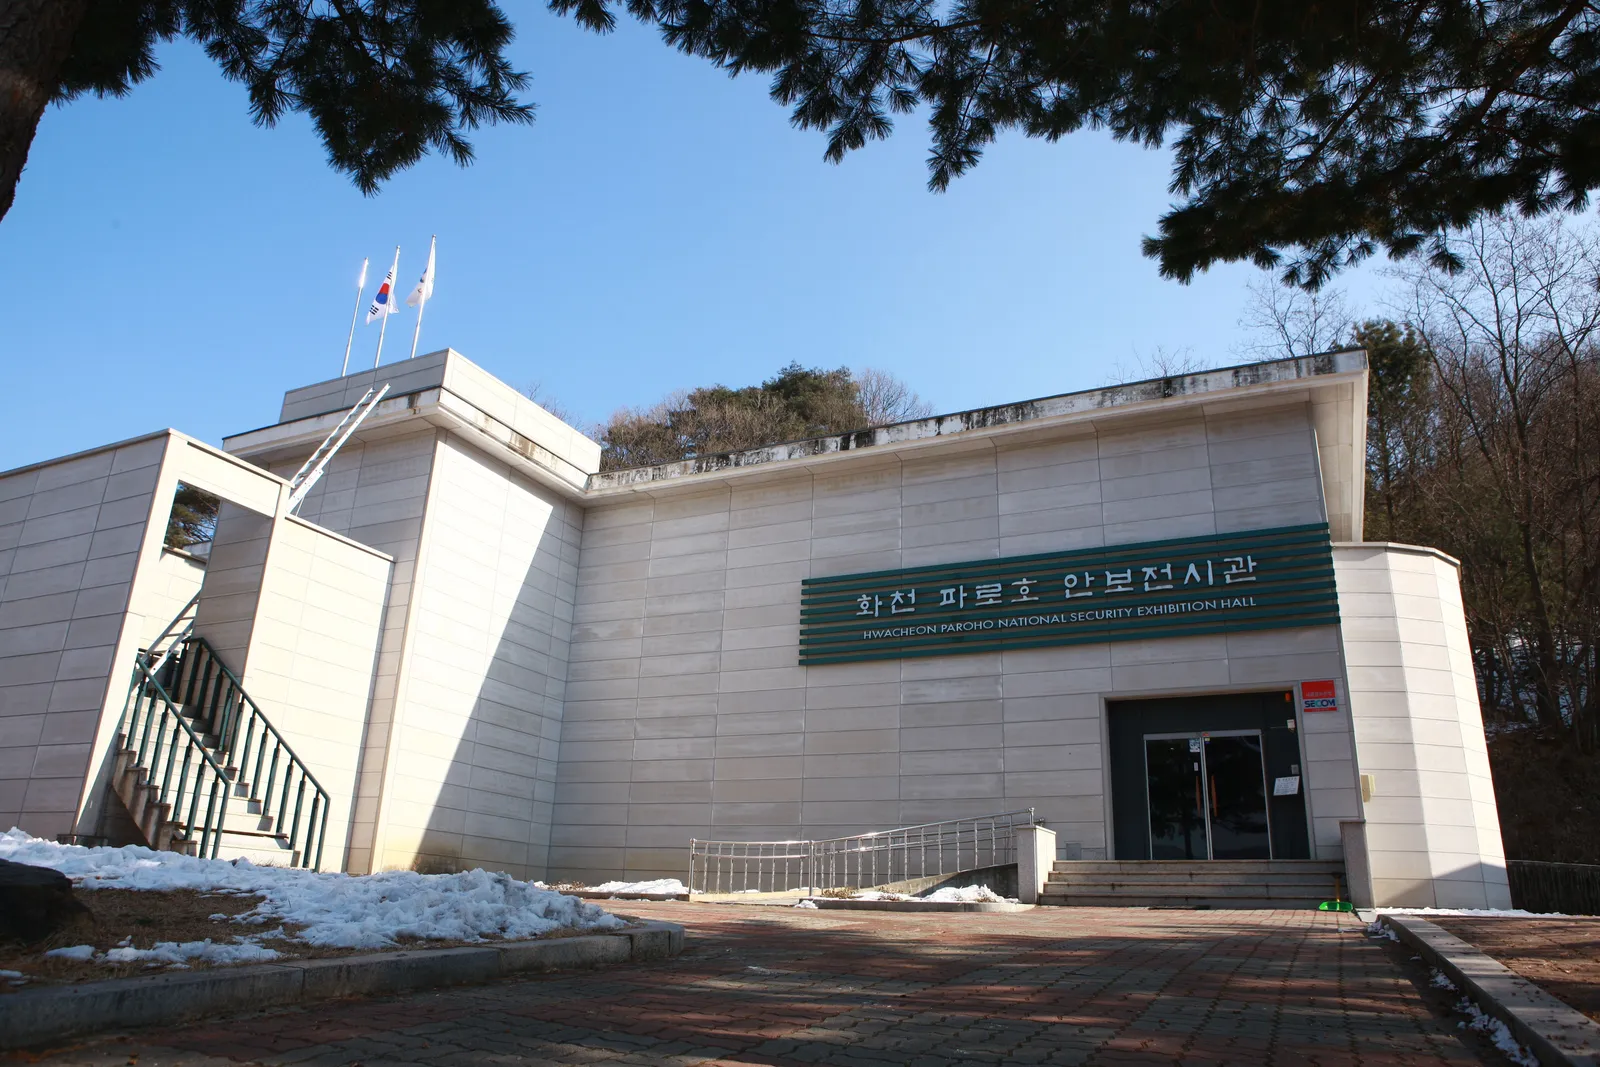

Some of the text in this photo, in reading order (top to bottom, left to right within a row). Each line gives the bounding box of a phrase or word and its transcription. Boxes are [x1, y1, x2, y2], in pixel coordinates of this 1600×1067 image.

[856, 555, 1257, 617] 화천 파로호 안보전시관
[863, 597, 1257, 639] HWACHEON PAROHO NATIONAL SECURITY EXHIBITION HALL
[1304, 699, 1336, 708] SECOM
